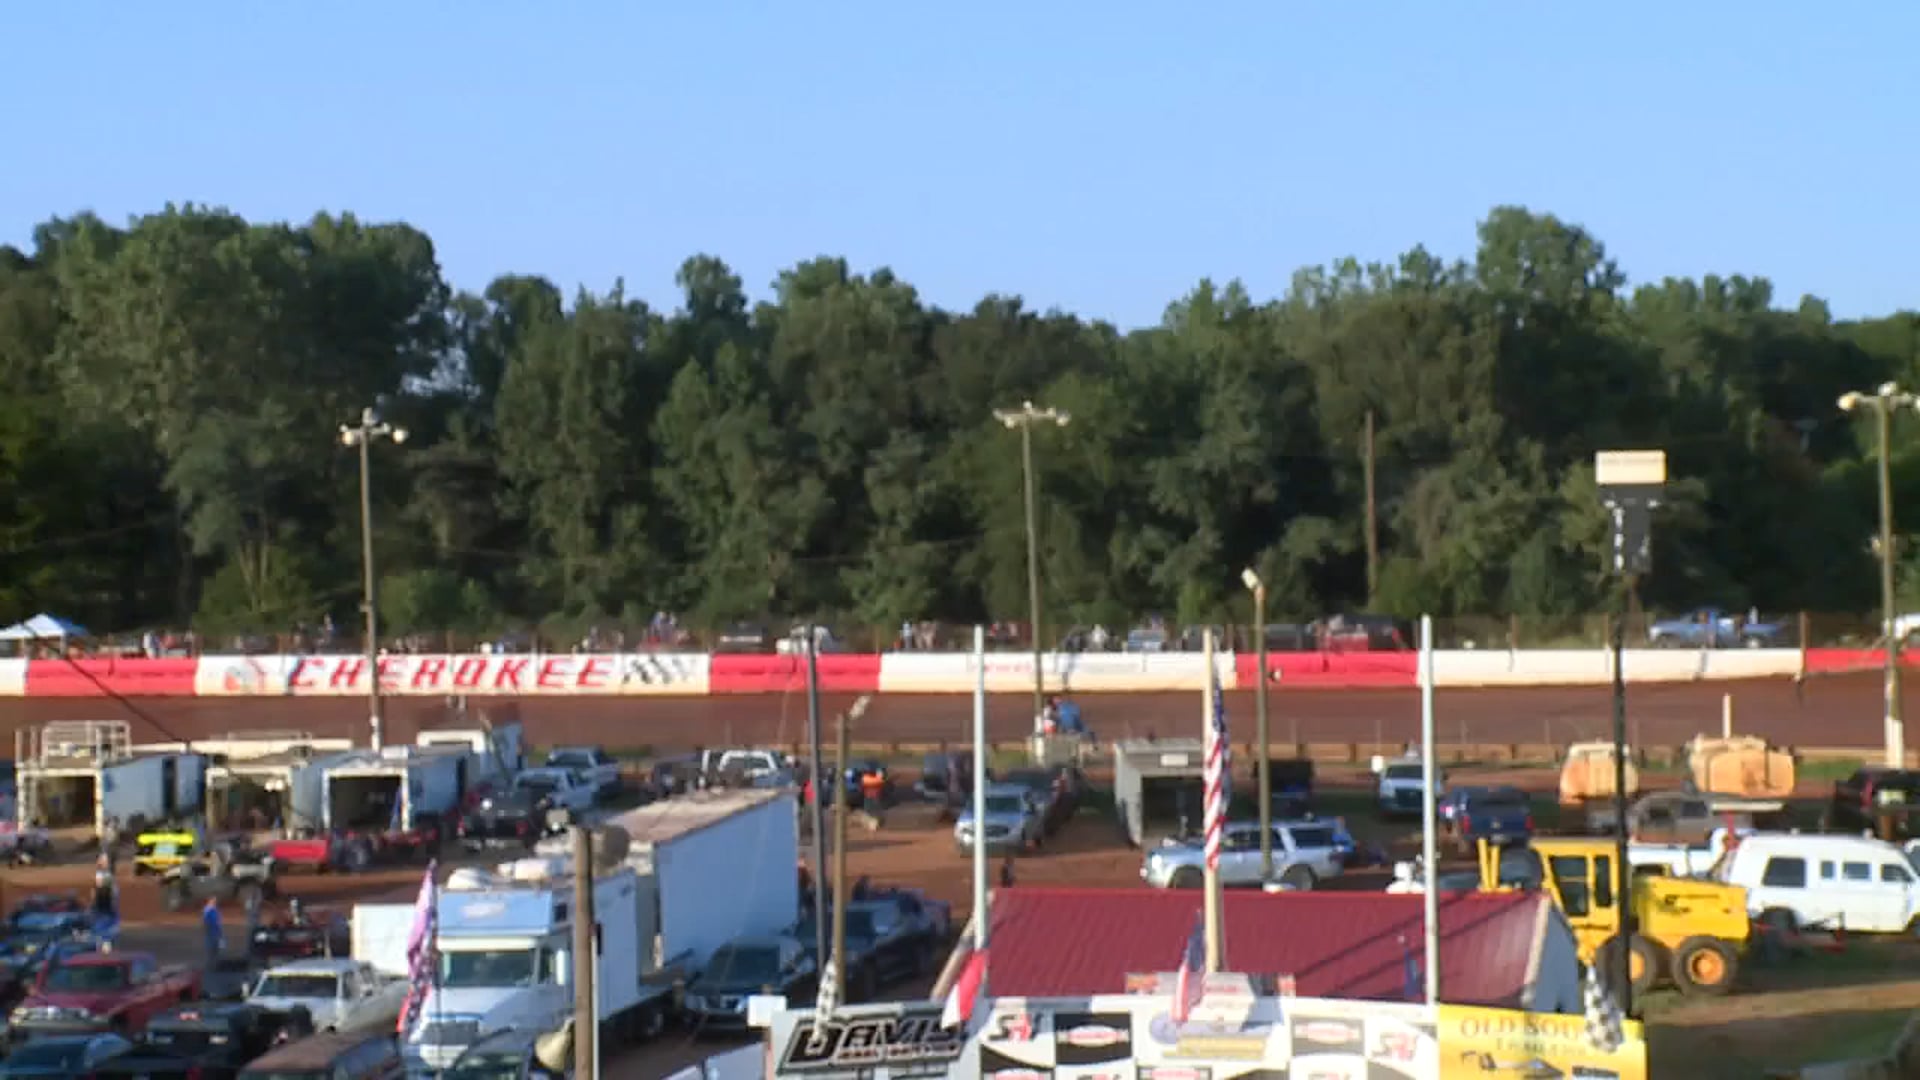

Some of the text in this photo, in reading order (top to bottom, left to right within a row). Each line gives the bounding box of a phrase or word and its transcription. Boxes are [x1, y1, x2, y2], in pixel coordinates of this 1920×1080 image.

[290, 655, 614, 690] CHEROKEE
[1460, 1012, 1586, 1041] OLD SOU
